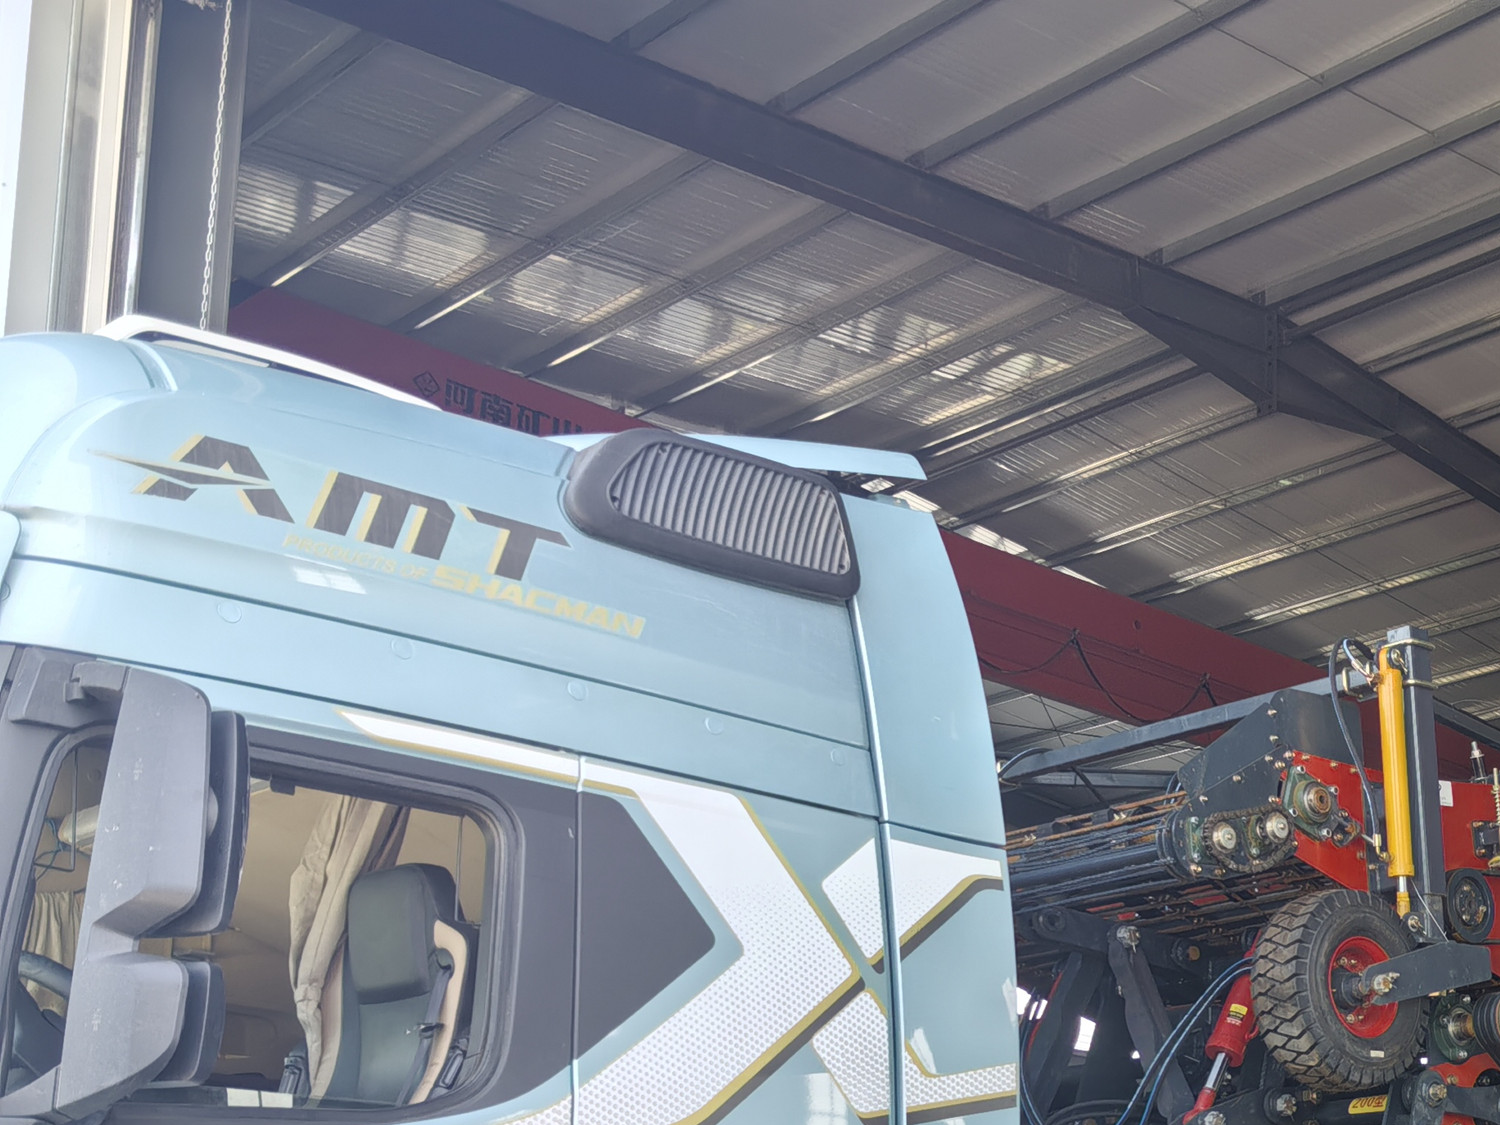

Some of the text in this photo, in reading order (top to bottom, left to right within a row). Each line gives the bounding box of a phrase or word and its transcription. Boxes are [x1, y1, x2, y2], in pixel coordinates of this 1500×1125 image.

[90, 435, 572, 581] AMT
[282, 534, 646, 639] PRODUCTS OF SHACMAN
